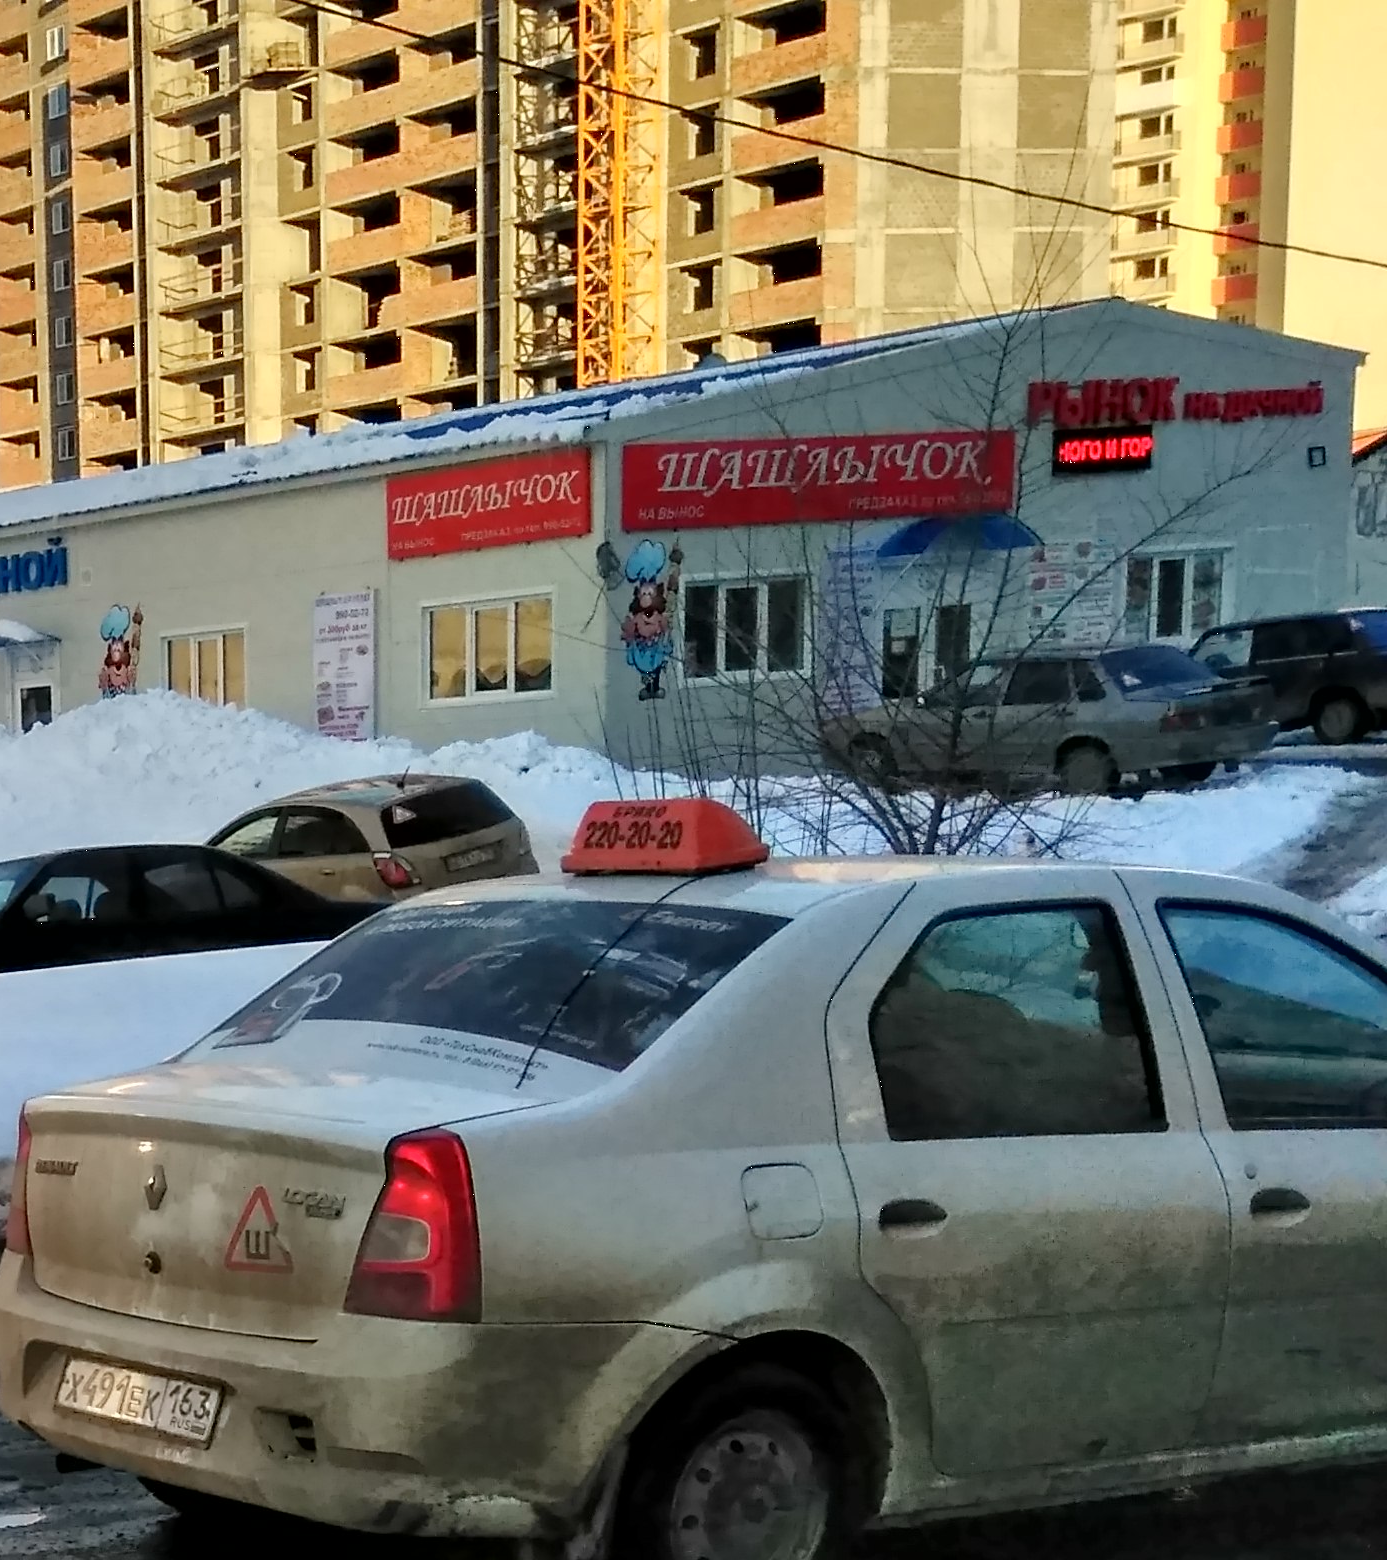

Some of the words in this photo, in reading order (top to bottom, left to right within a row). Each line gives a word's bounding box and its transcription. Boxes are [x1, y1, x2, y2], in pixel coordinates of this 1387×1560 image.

[1027, 377, 1180, 427] РЫНОК
[1105, 438, 1118, 459] И
[1120, 436, 1153, 459] ГОР
[657, 440, 992, 497] ШАШЛЫЧОК
[392, 470, 582, 526] ШАШЛЫЧОК
[638, 507, 656, 519] НА
[658, 504, 705, 519] ВЫНОС
[583, 820, 683, 850] 220-20-20
[244, 1229, 271, 1260] Ш
[169, 1384, 210, 1420] 163
[169, 1415, 192, 1431] RUS
